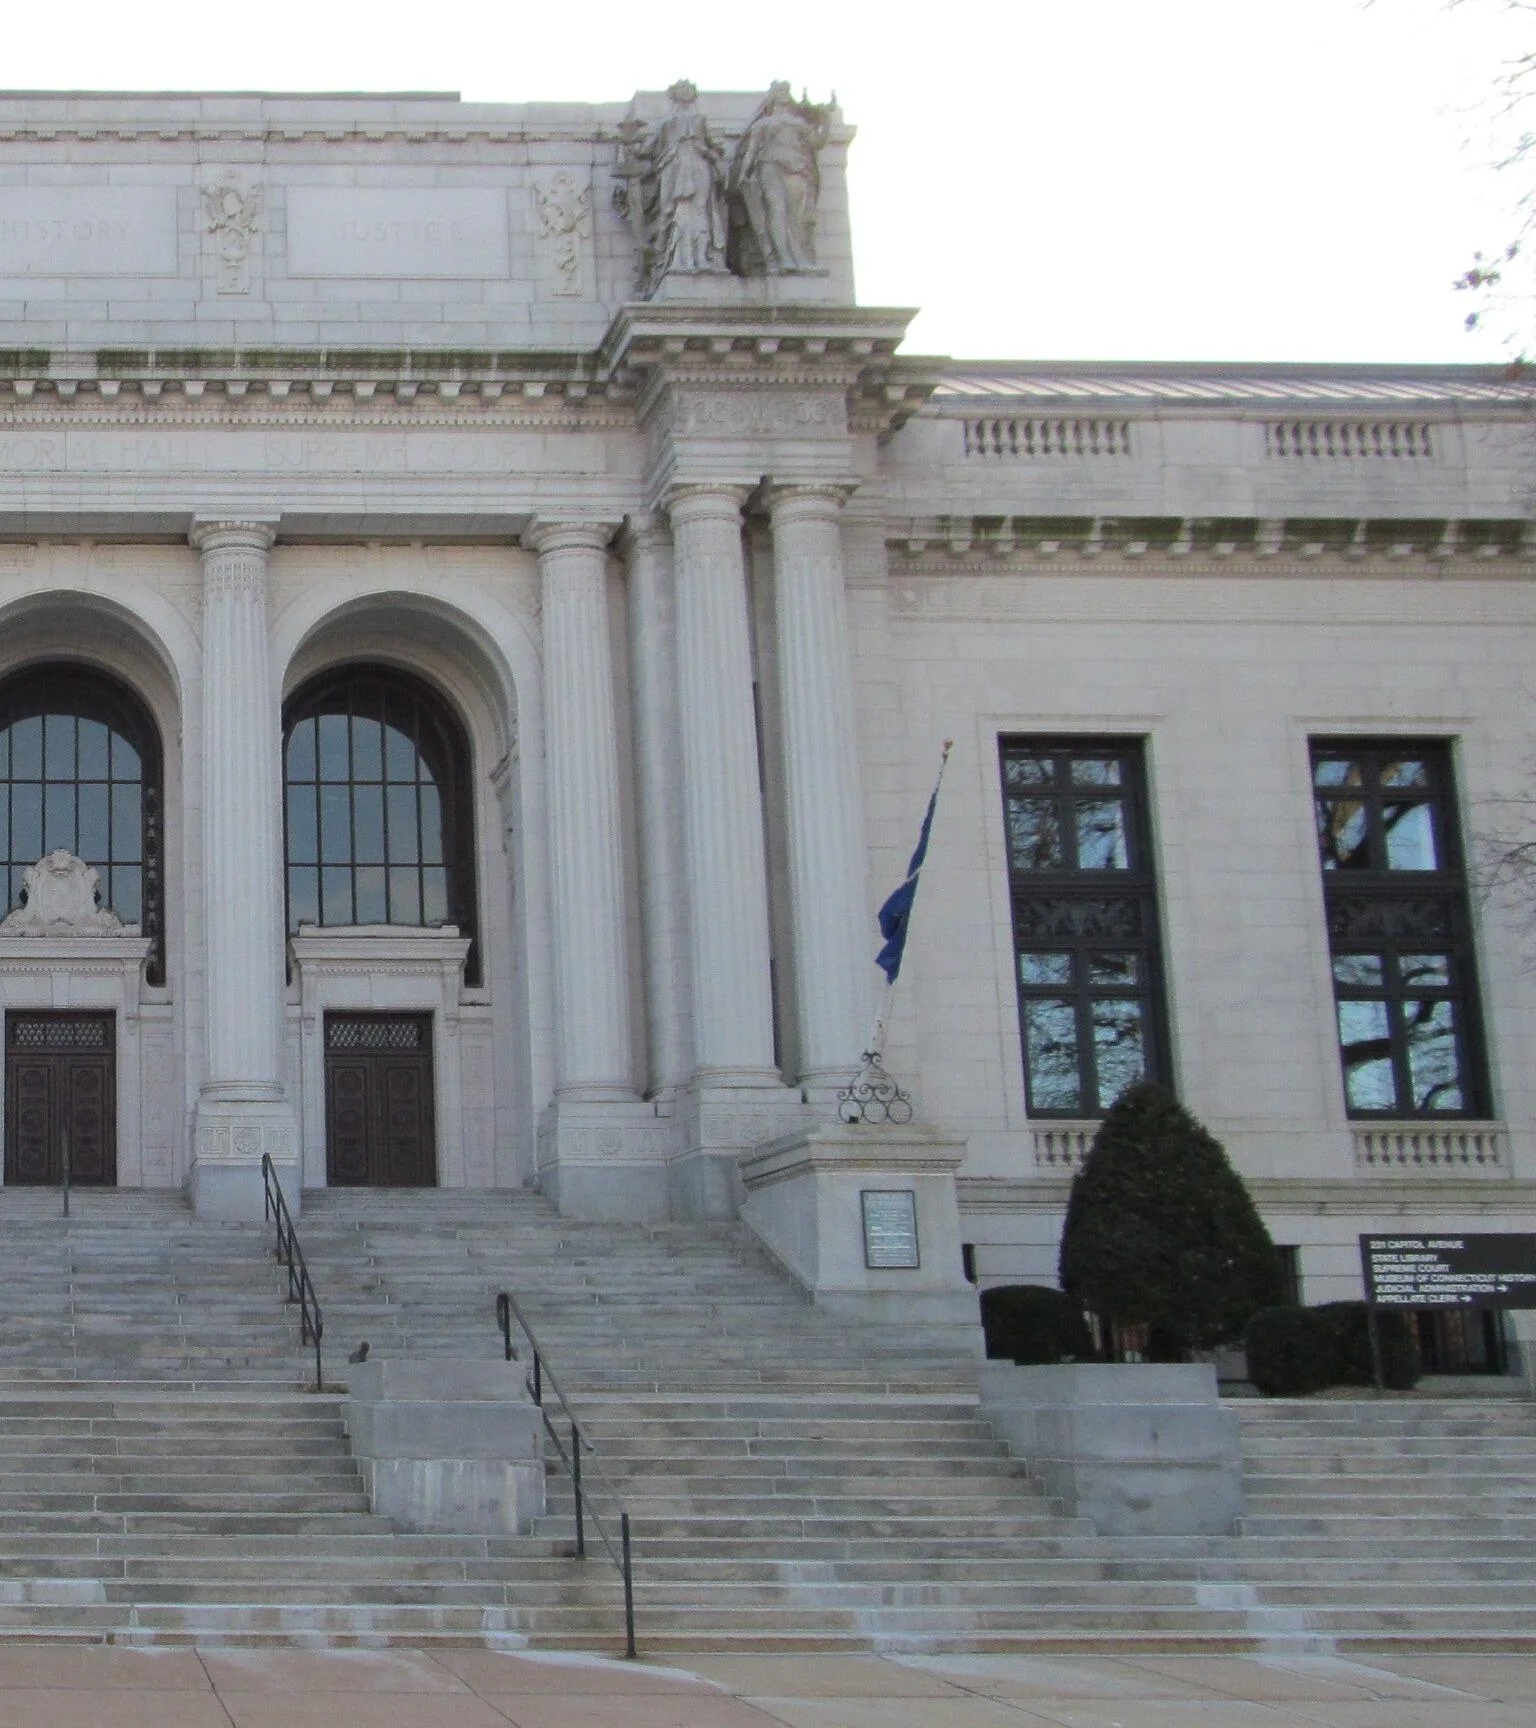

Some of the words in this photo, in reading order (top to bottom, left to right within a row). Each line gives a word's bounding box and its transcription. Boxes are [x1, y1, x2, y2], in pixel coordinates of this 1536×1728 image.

[0, 219, 131, 242] HISTORY
[333, 220, 465, 243] JUSTICE
[118, 438, 202, 468] HALL
[264, 439, 408, 469] SUPREME
[425, 439, 540, 469] COURT
[1387, 1240, 1425, 1249] CAPITOL
[1427, 1240, 1464, 1249] AVENUE
[1371, 1254, 1399, 1263] STATE
[1401, 1254, 1438, 1263] LIBRARY
[1373, 1264, 1416, 1273] SUPREME
[1418, 1264, 1450, 1273] COURT
[1374, 1274, 1414, 1283] MUSEUM
[1416, 1274, 1429, 1283] OF
[1431, 1274, 1496, 1282] CONNECTICUT
[1375, 1284, 1416, 1293] JUDICIAL
[1418, 1284, 1495, 1292] ADMINISTRATION
[1376, 1294, 1426, 1303] APPELLATE
[1428, 1294, 1458, 1303] CLERK
